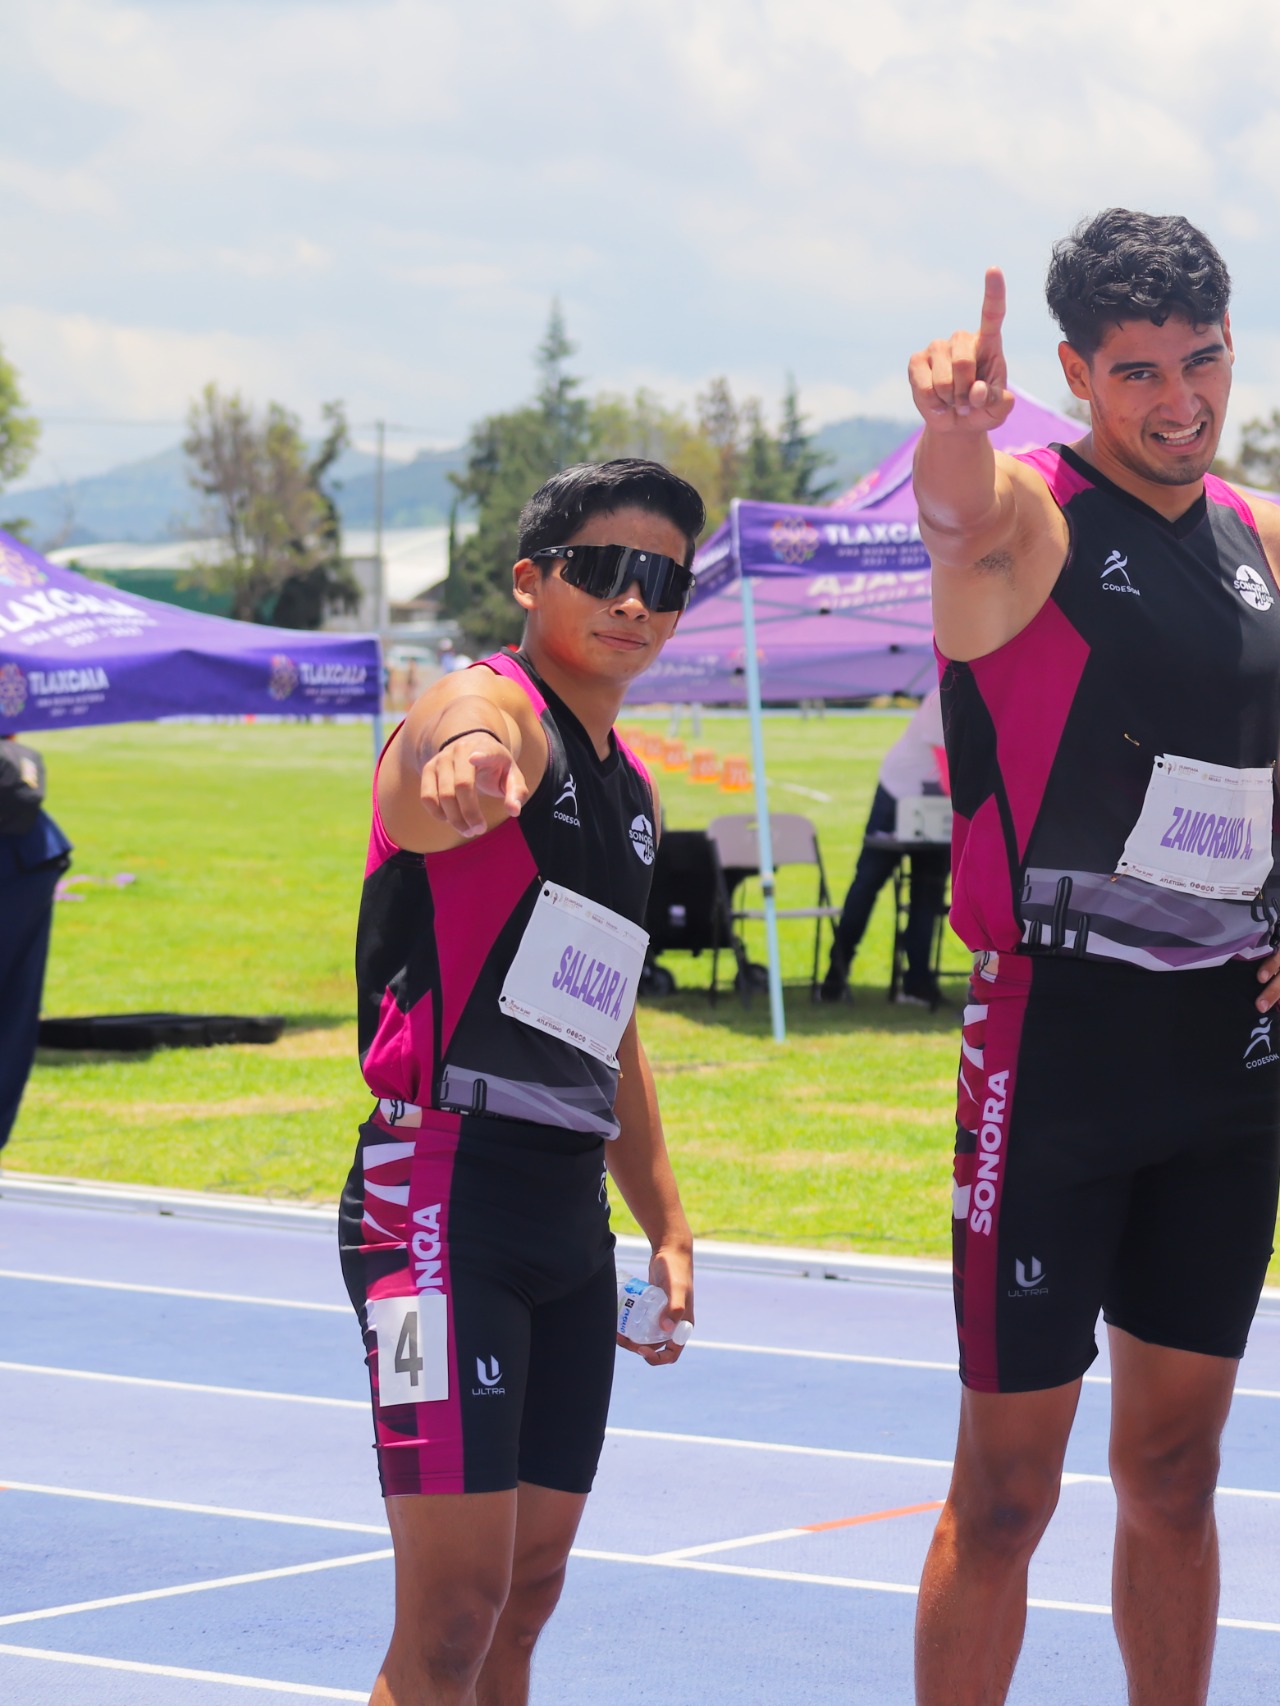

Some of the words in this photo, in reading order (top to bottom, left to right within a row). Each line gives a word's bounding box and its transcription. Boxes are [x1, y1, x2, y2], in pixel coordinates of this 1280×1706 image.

[1102, 583, 1141, 597] CODESON
[28, 667, 110, 696] TLAXCALA
[1160, 806, 1246, 860] ZAMORANO
[552, 945, 621, 1017] SALAZAR
[1245, 1053, 1280, 1069] CODESON
[970, 1069, 1010, 1236] SONORA
[1007, 1287, 1049, 1297] ULTRA
[394, 1311, 424, 1387] 4
[472, 1387, 506, 1396] ULTRA
